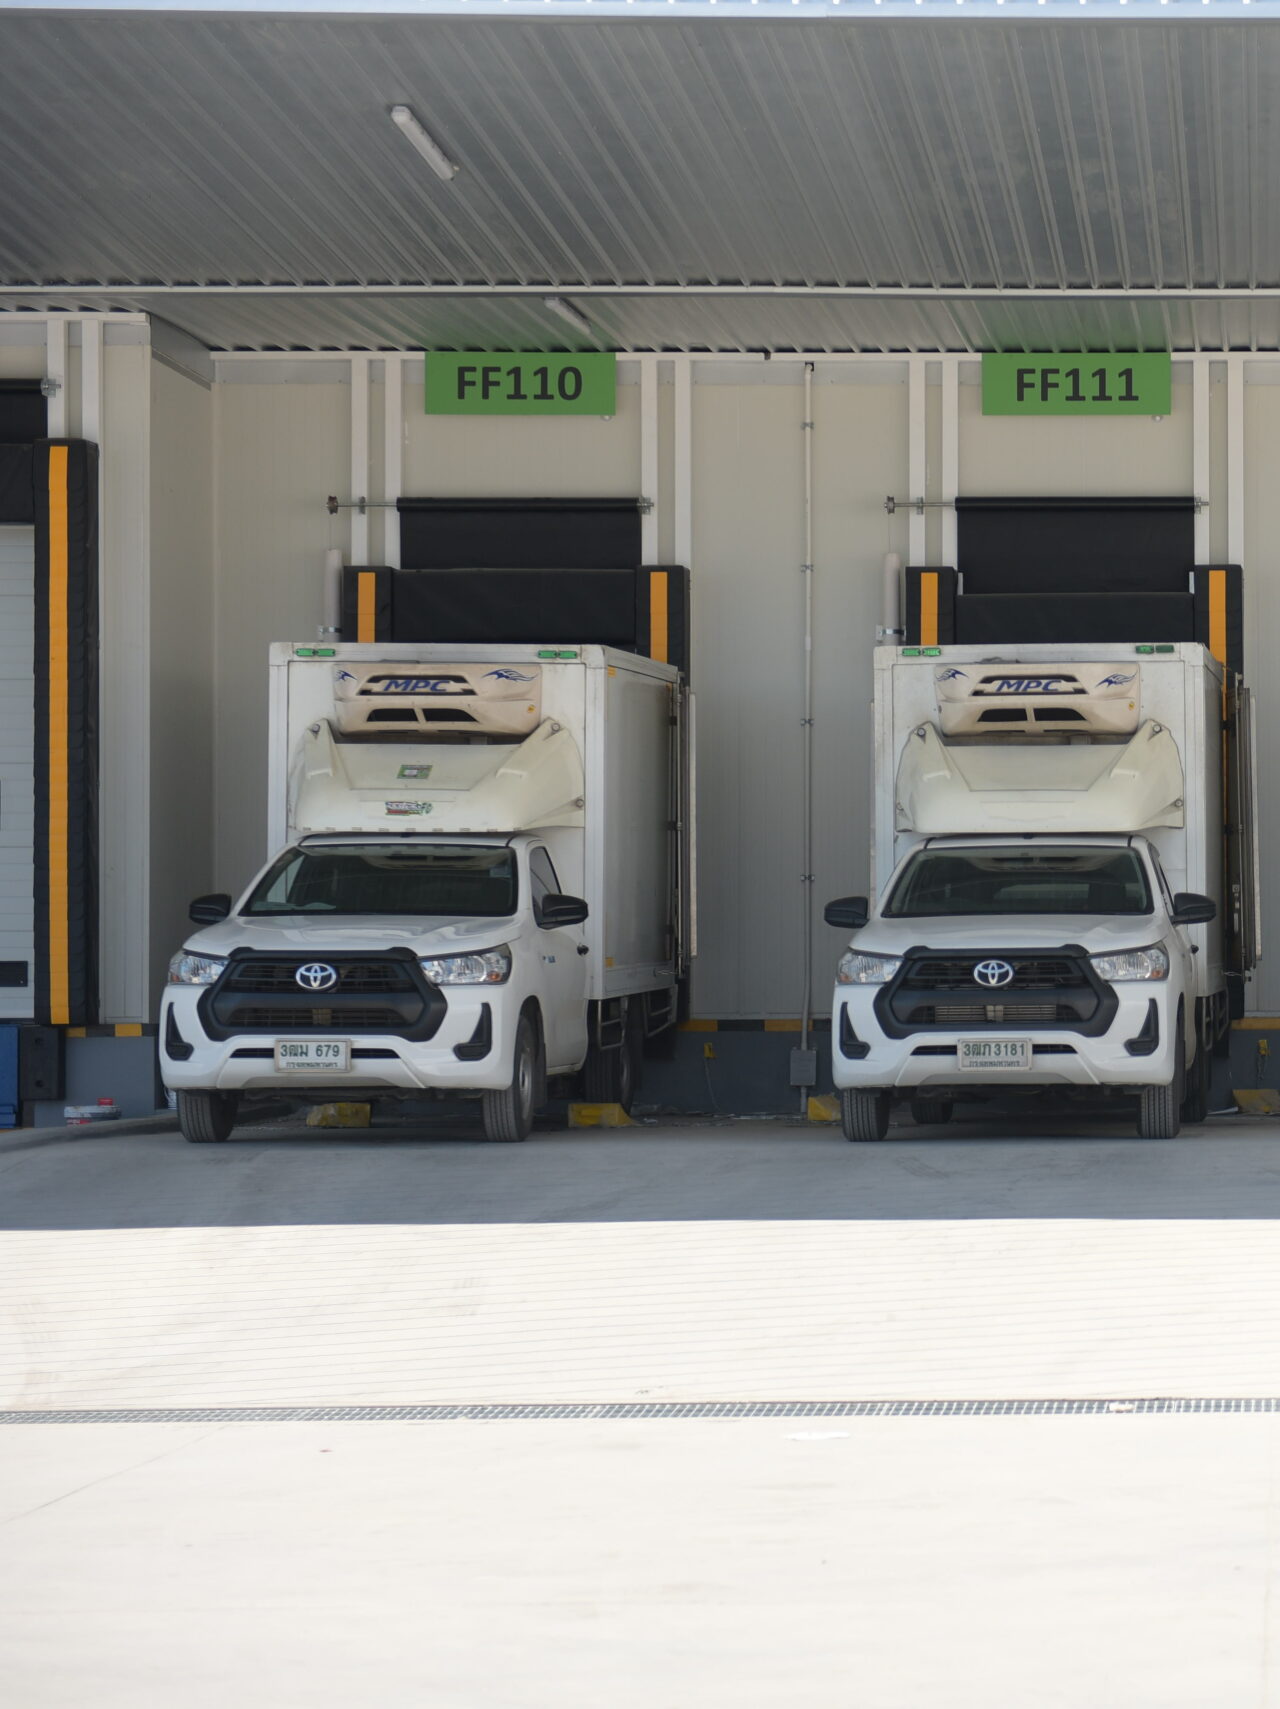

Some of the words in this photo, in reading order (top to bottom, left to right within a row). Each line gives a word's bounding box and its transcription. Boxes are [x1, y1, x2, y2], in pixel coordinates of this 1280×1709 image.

[457, 366, 583, 401] FF110
[1016, 367, 1139, 402] FF111
[383, 679, 451, 692] MPC
[995, 679, 1063, 692] MPC
[315, 1043, 340, 1057] 679
[994, 1043, 1025, 1056] 3181
